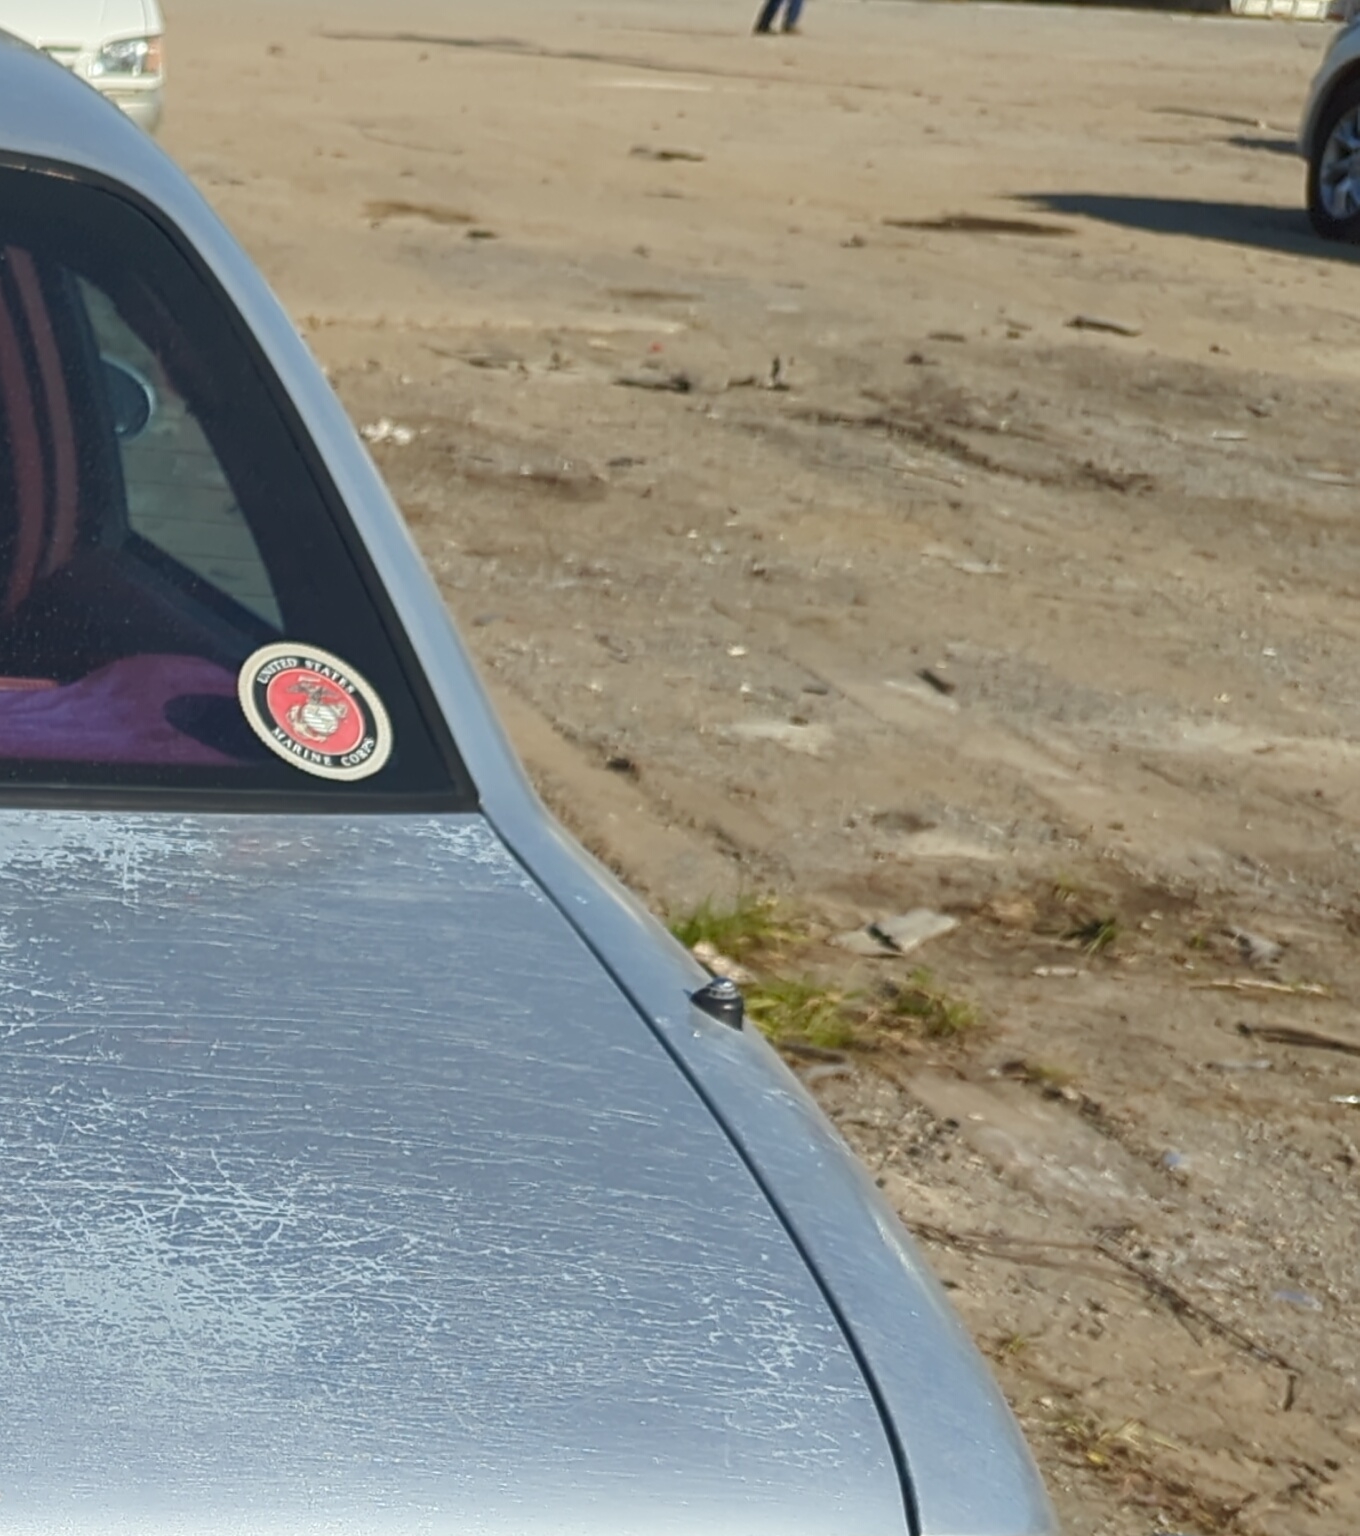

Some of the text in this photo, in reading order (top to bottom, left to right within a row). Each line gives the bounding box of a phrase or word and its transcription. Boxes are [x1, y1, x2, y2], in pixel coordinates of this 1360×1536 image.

[256, 657, 356, 695] UNITED STATES
[271, 726, 376, 767] MARINE CORPS
